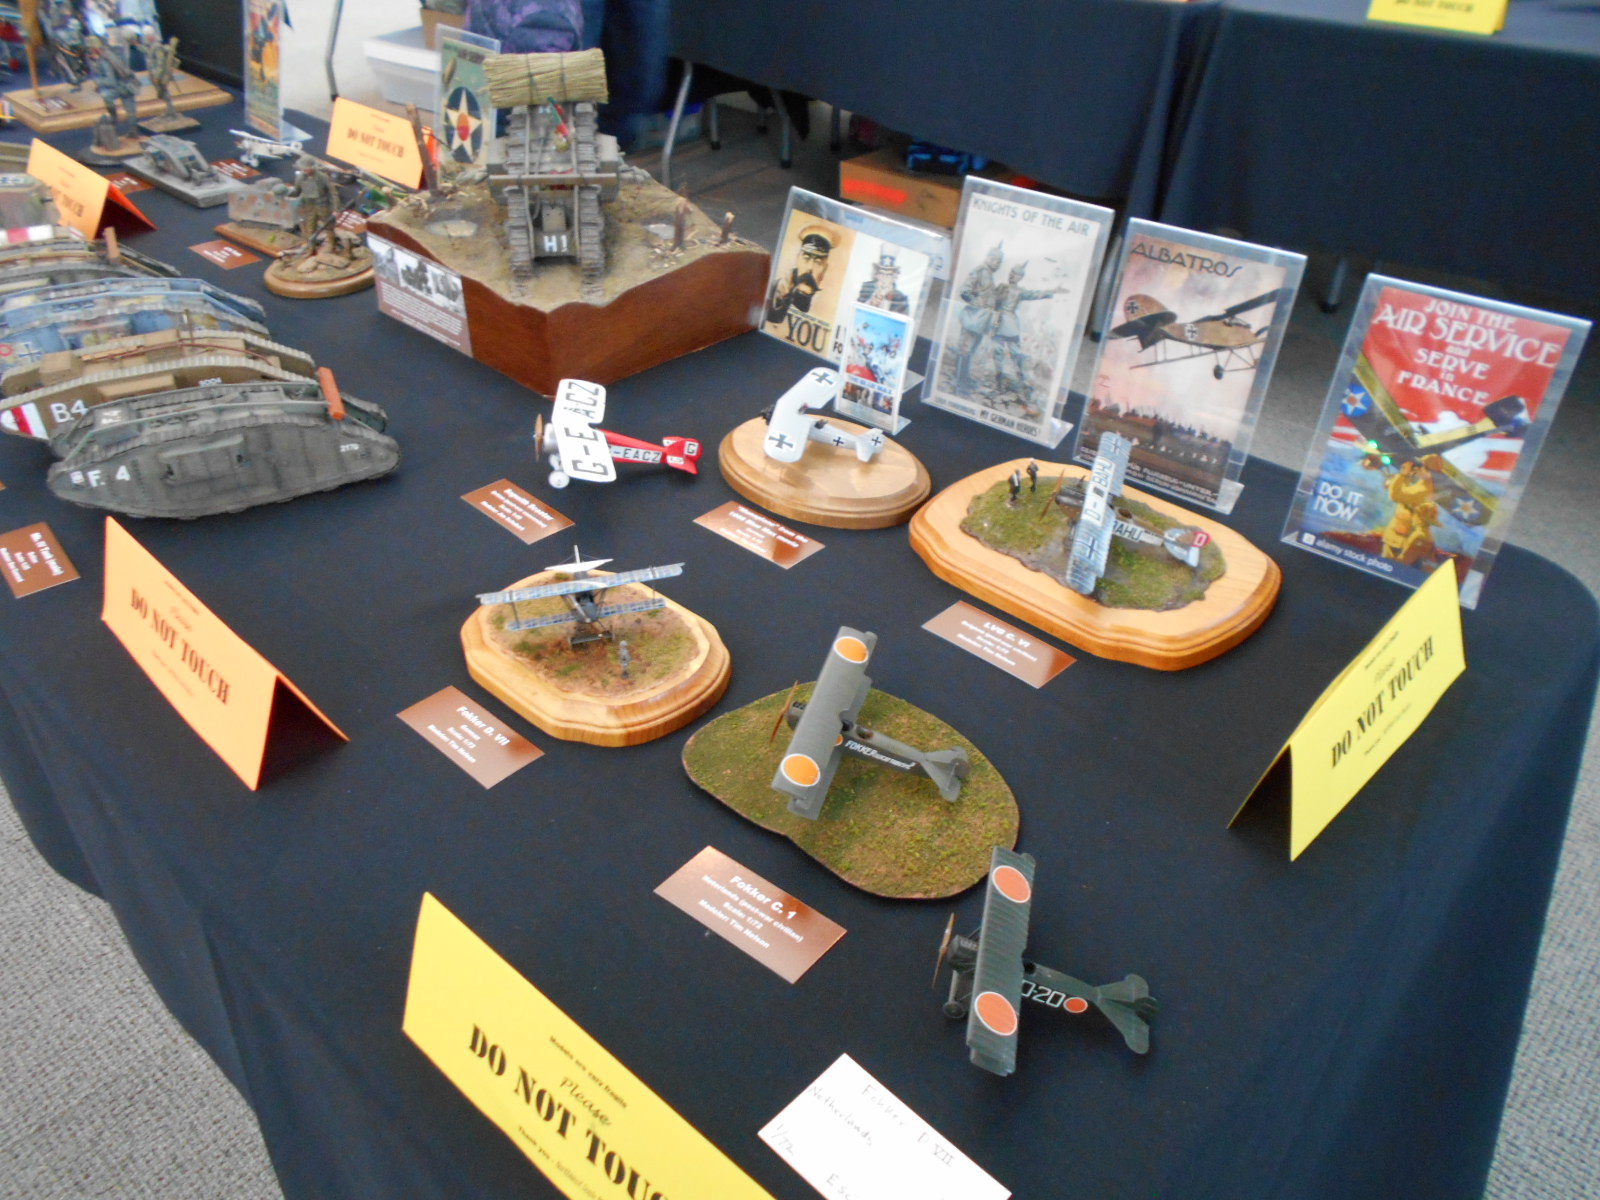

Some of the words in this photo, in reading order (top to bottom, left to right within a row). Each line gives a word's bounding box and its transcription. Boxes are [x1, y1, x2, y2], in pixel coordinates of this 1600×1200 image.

[973, 199, 1018, 218] KNIGHTS
[1022, 210, 1039, 223] OF
[1041, 214, 1064, 230] THE
[1067, 221, 1090, 236] AIR
[1131, 243, 1242, 277] ALBATROS
[786, 313, 832, 352] YOU
[1425, 300, 1470, 320] JOIN
[1479, 310, 1517, 333] THE
[1373, 304, 1427, 335] AIR
[1430, 317, 1562, 368] SERVICE
[1414, 347, 1491, 380] SERVE
[1397, 370, 1491, 405] FRANCE
[607, 445, 662, 463] -EACZ
[687, 442, 697, 455] G
[1313, 495, 1359, 521] NOW
[1319, 481, 1343, 499] DO
[1347, 491, 1364, 506] IT
[131, 587, 149, 620] DO
[150, 608, 179, 650] NOT
[181, 639, 231, 706] TOUCH
[1331, 730, 1352, 769] DO
[1356, 690, 1386, 739] NOT
[1389, 635, 1434, 701] TOUCH
[457, 706, 487, 728] Fokker
[484, 726, 496, 735] D.
[493, 733, 509, 745] VII
[730, 875, 771, 904] Fokker
[770, 901, 786, 913] C.
[784, 910, 796, 919] 1
[699, 899, 729, 921] Modeler:
[729, 919, 744, 931] Tim
[744, 929, 769, 947] Nelson
[469, 1024, 506, 1077] DO
[514, 1066, 576, 1140] NOT
[586, 1129, 669, 1200] TOU
[560, 1077, 611, 1125] Please
